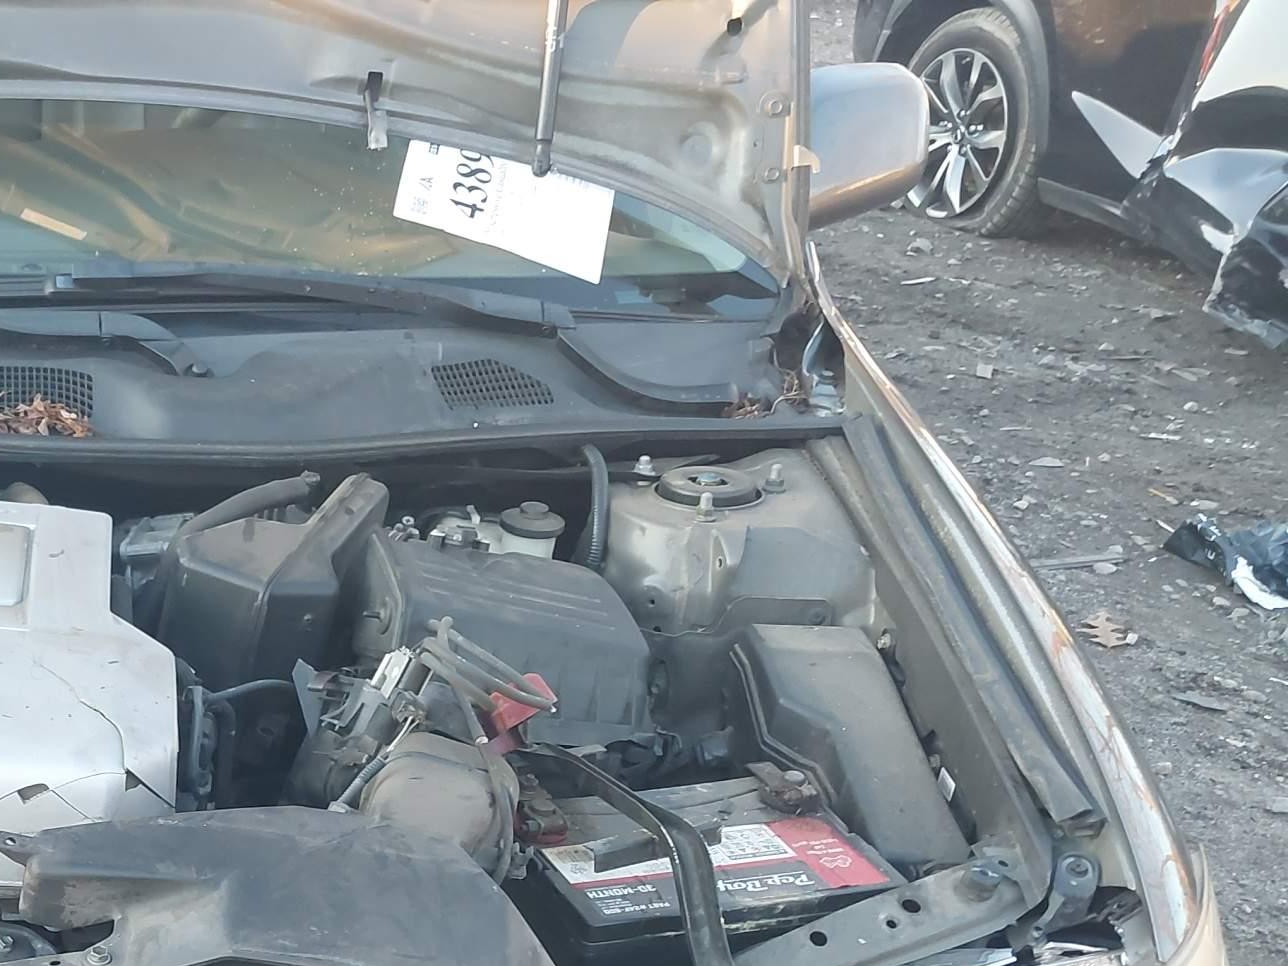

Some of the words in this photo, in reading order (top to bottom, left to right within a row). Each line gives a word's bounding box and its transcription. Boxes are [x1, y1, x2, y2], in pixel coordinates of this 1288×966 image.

[716, 879, 769, 892] Boy
[764, 871, 816, 887] Pep
[585, 884, 657, 899] 30-MONTH
